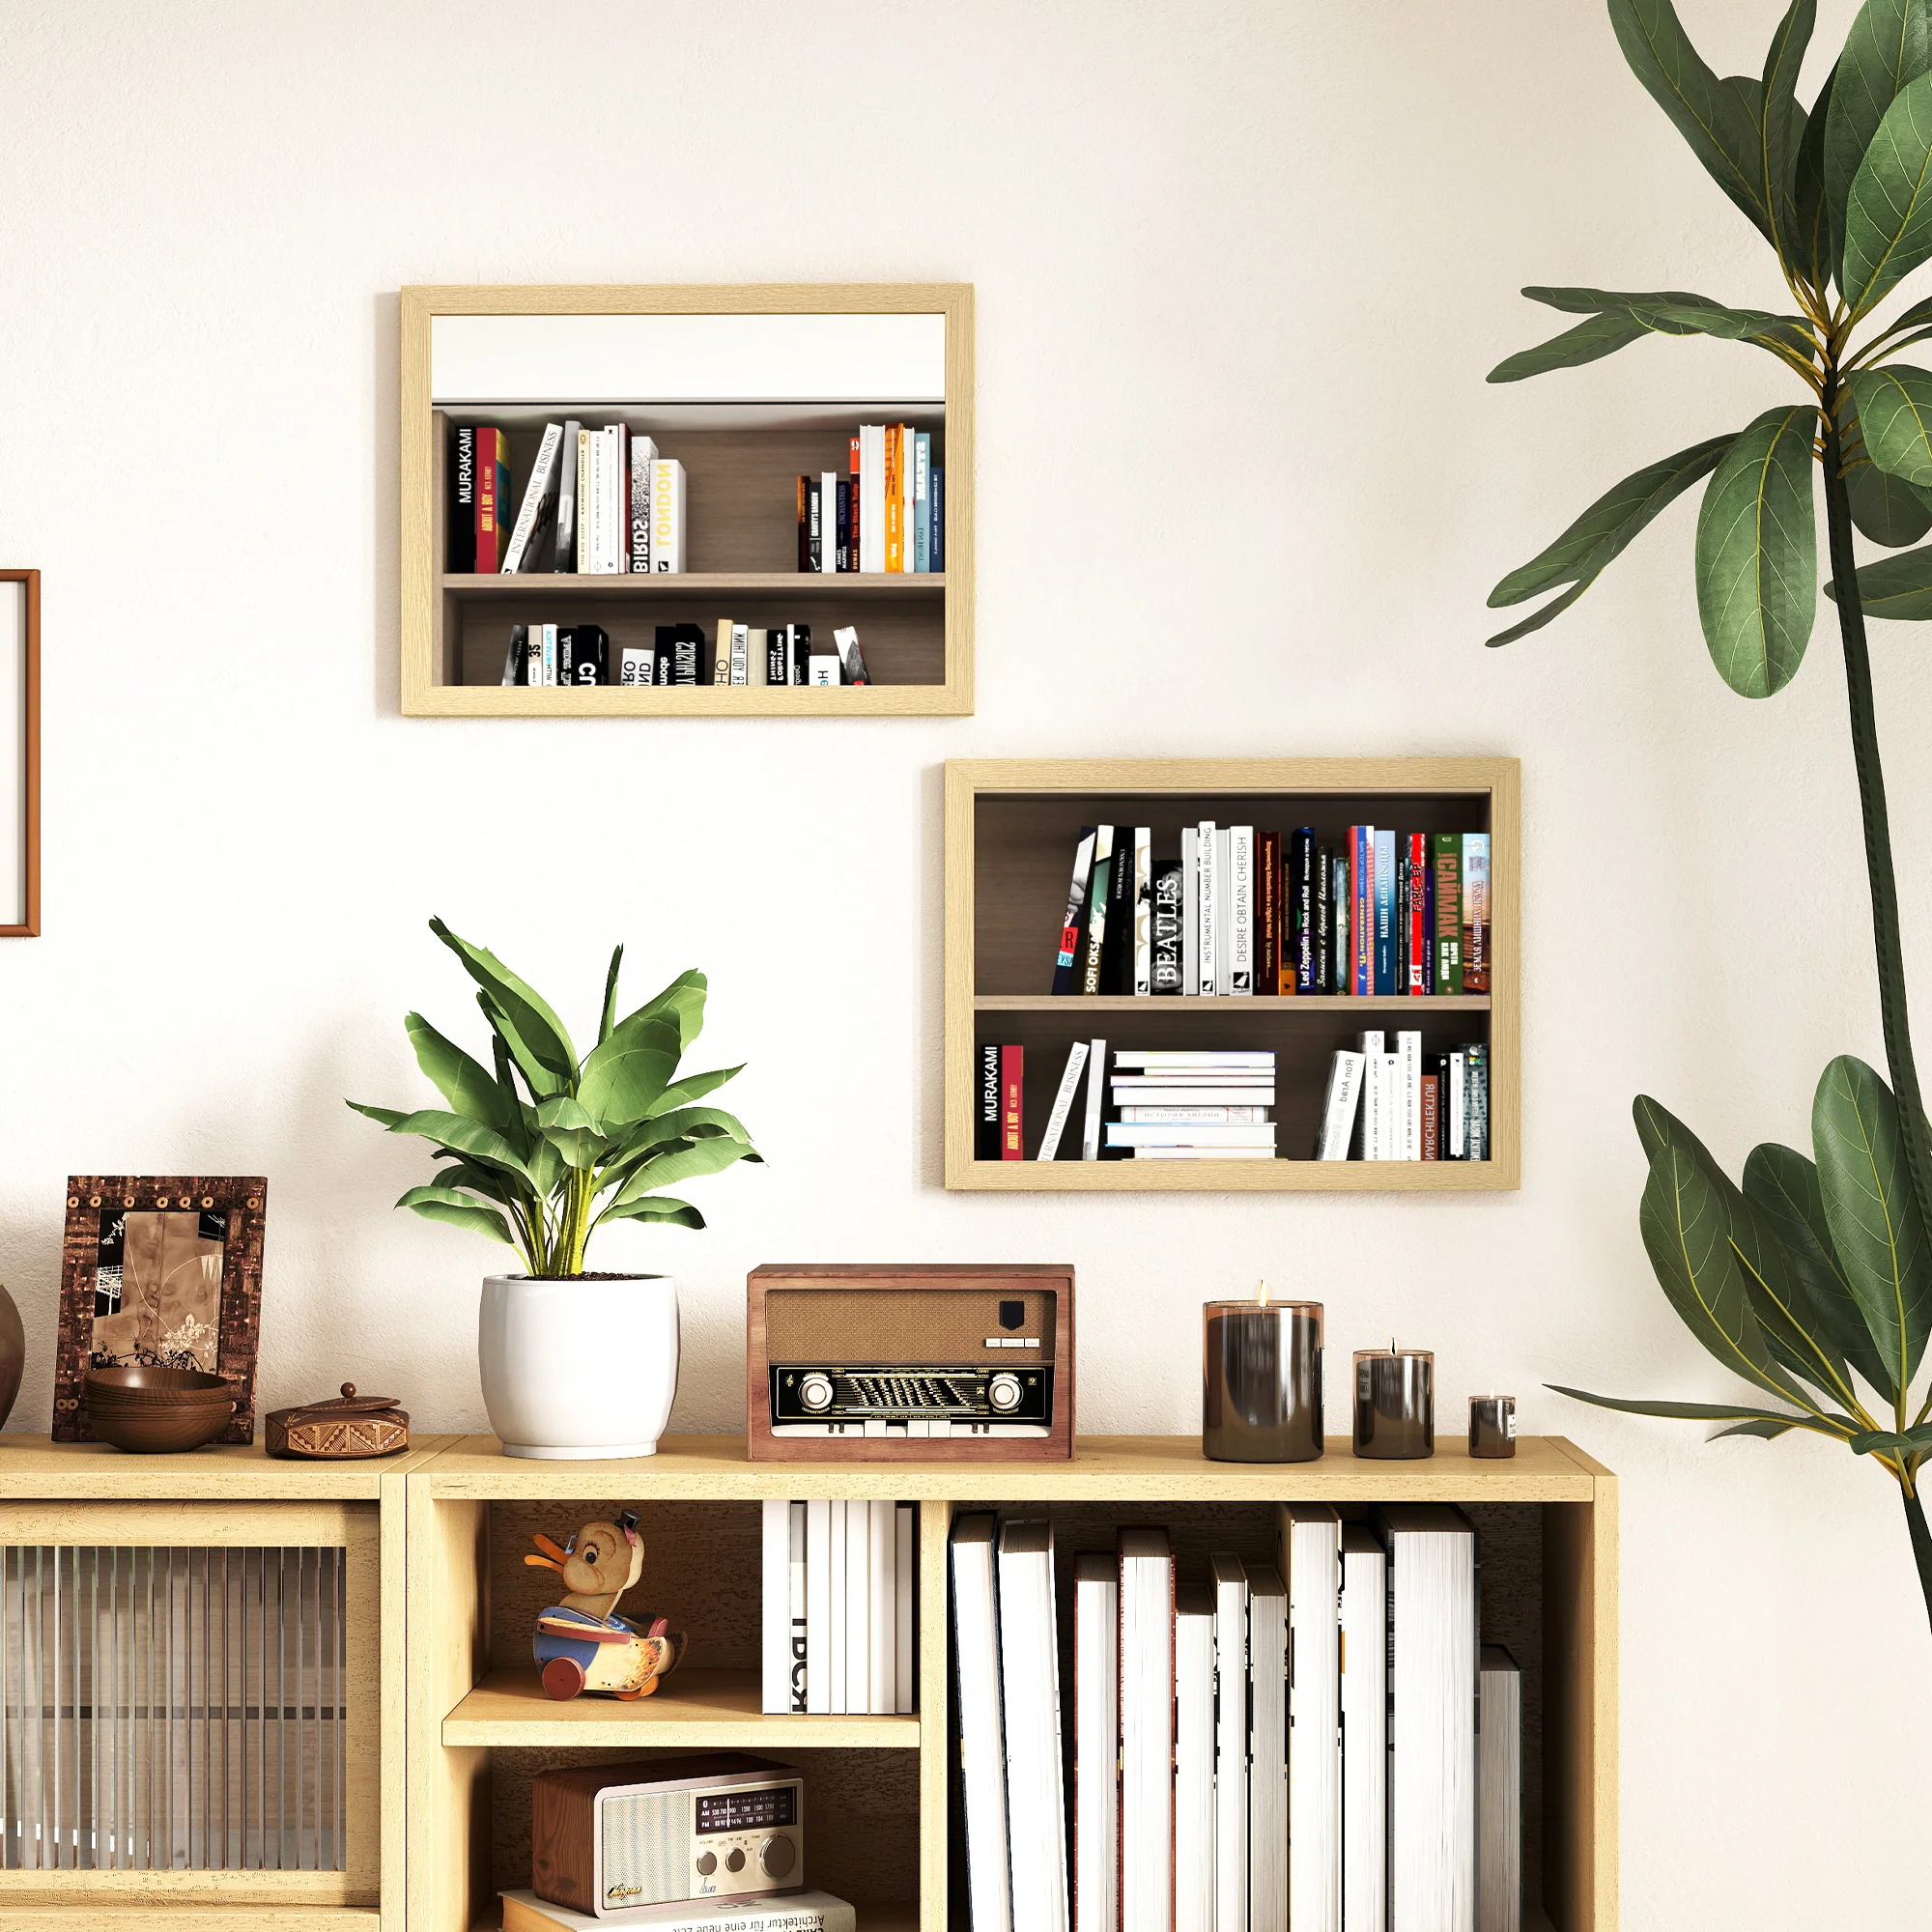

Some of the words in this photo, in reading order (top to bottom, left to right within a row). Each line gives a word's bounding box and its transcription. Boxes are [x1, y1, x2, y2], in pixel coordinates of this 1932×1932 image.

[459, 428, 472, 503] MURAKAMI
[481, 494, 493, 505] BOY
[511, 479, 543, 554] INTERNATIONAL
[535, 431, 557, 474] BUSINESS
[481, 514, 493, 531] ABOUT
[528, 644, 541, 658] 35
[1236, 837, 1247, 881] CHERISH
[1301, 885, 1310, 898] Roll
[1437, 858, 1461, 938] САЙМАК
[1236, 885, 1247, 923] OBTAIN
[1301, 899, 1310, 911] and
[1157, 879, 1178, 982] BEATLES
[1301, 912, 1310, 927] Rock
[1318, 903, 1327, 936] берегов
[1379, 908, 1389, 938] НАШИ
[1236, 927, 1247, 962] DESIRE
[1300, 936, 1312, 970] Zeppelin
[1440, 942, 1449, 956] КАК
[1317, 949, 1325, 987] Записки
[1440, 958, 1449, 980] ЛЮДИ
[1473, 947, 1482, 972] ЗЕМЛЯ
[1086, 968, 1097, 993] SOFI
[1300, 971, 1310, 986] Led
[985, 1046, 998, 1122] MURAKAMI
[1064, 1051, 1084, 1094] BUSINESS
[1008, 1111, 1018, 1123] BOY
[1007, 1132, 1018, 1150] ABOUT
[696, 1923, 722, 1932] neue
[724, 1921, 747, 1932] eine
[750, 1919, 764, 1931] für
[767, 1915, 825, 1929] Architektur
